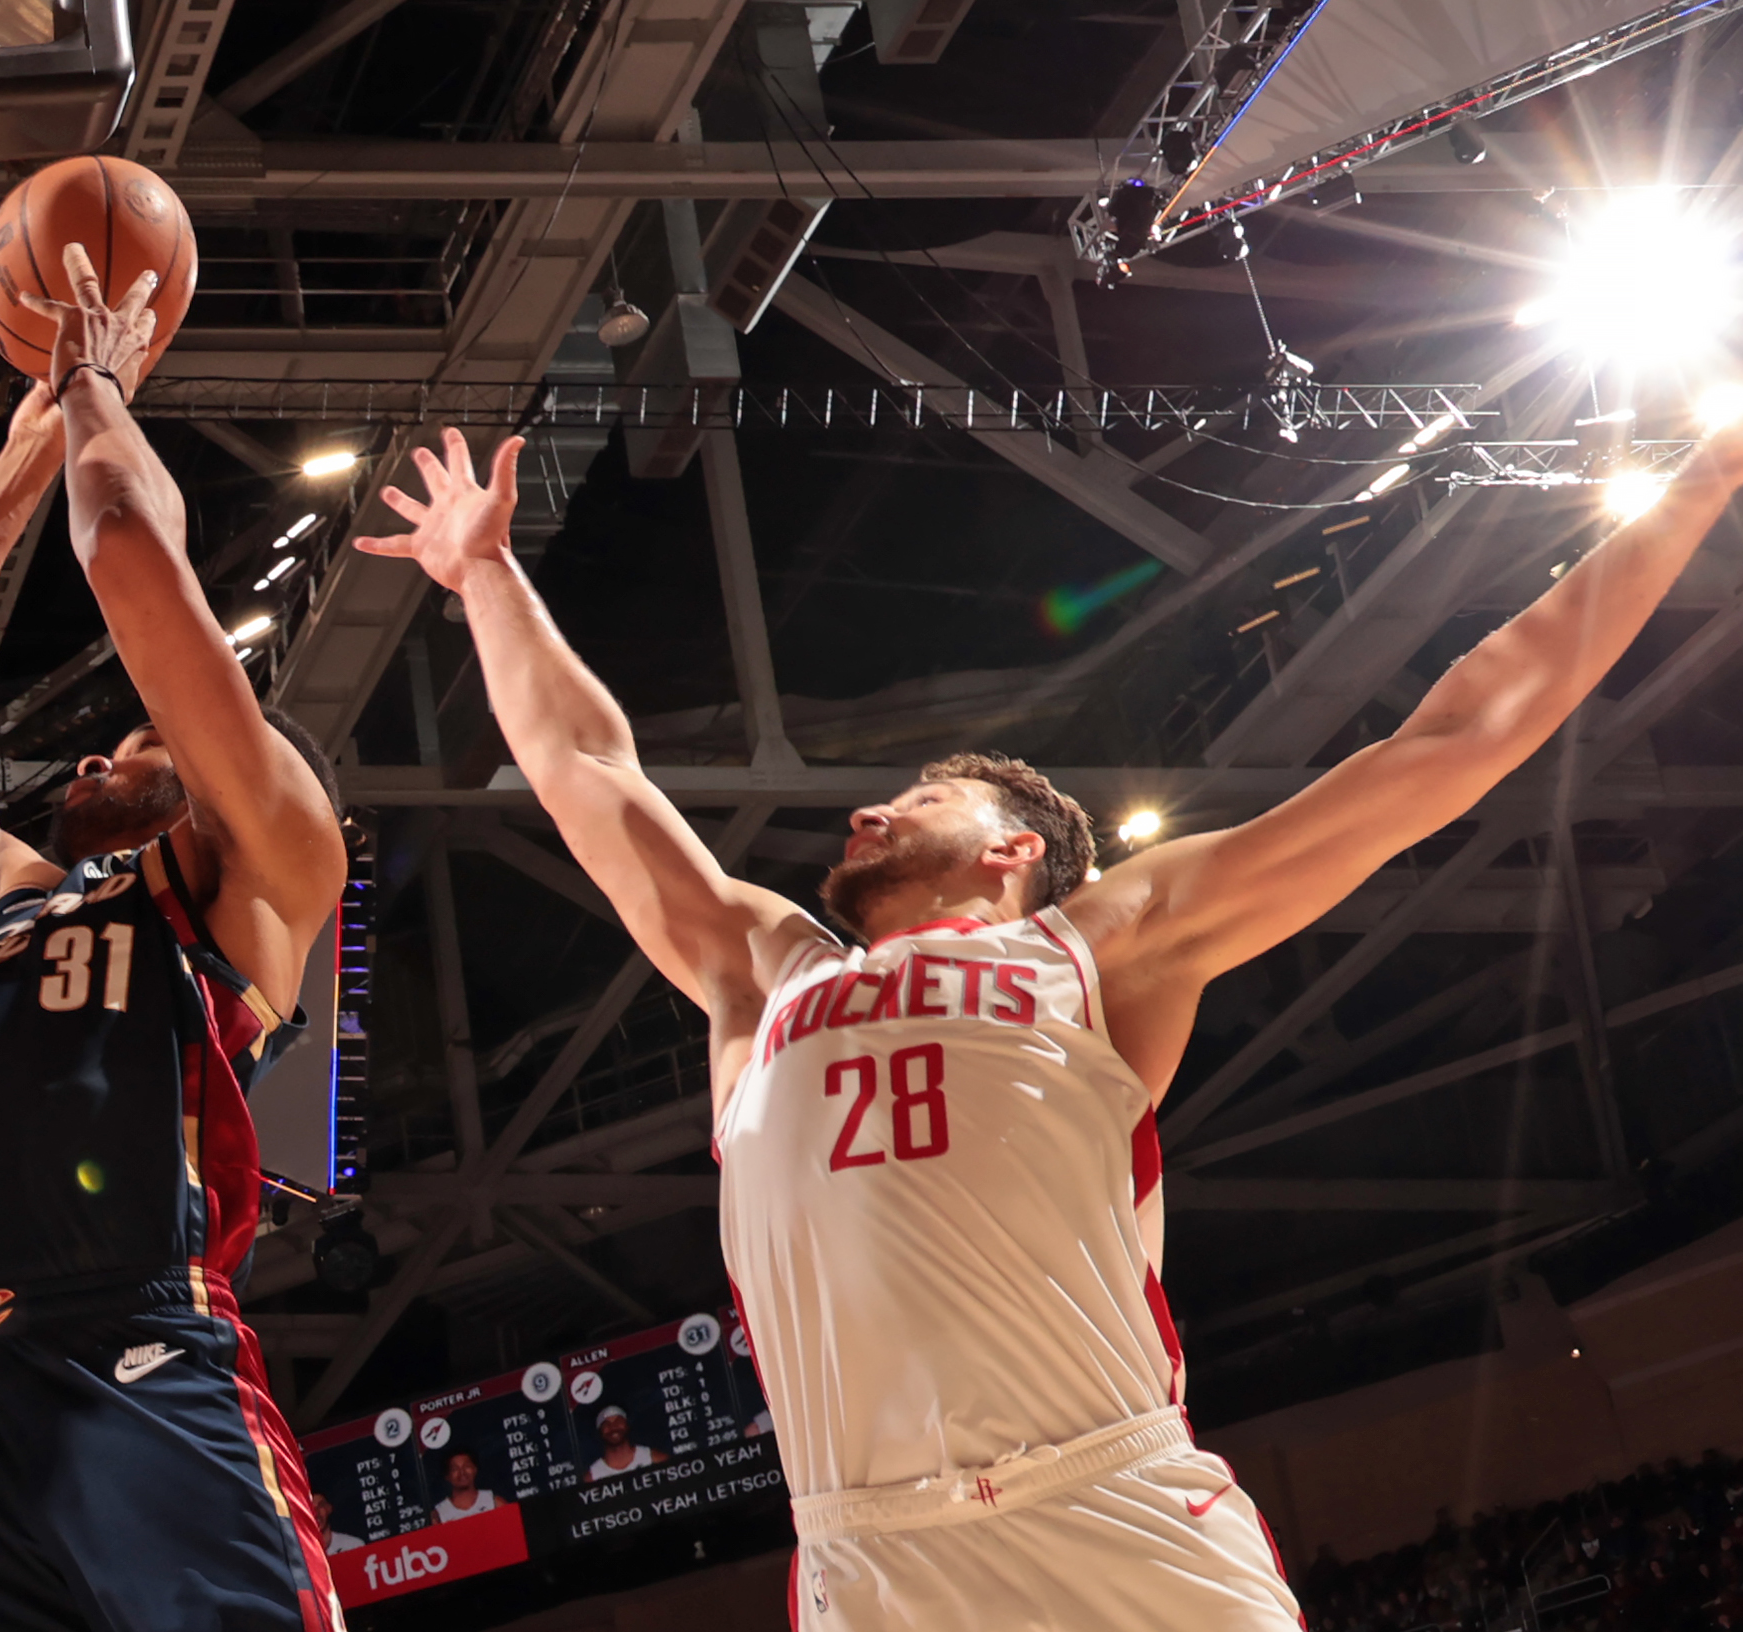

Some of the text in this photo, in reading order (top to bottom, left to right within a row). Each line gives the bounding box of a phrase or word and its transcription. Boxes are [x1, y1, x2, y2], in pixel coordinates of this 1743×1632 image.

[38, 921, 136, 1013] 31
[762, 954, 1038, 1067] ROCKETS
[823, 1042, 949, 1173] 28
[122, 1341, 167, 1366] NIKE
[570, 1348, 608, 1368] ALLEN
[687, 1326, 711, 1346] 31
[419, 1387, 481, 1413] PORTER JR
[579, 1481, 623, 1505] YEAH
[633, 1459, 705, 1491] LET'SGO
[714, 1443, 762, 1467] YEAH
[571, 1469, 781, 1538] LET'SGO YEAH LET'SGO
[364, 1545, 449, 1590] fubo
